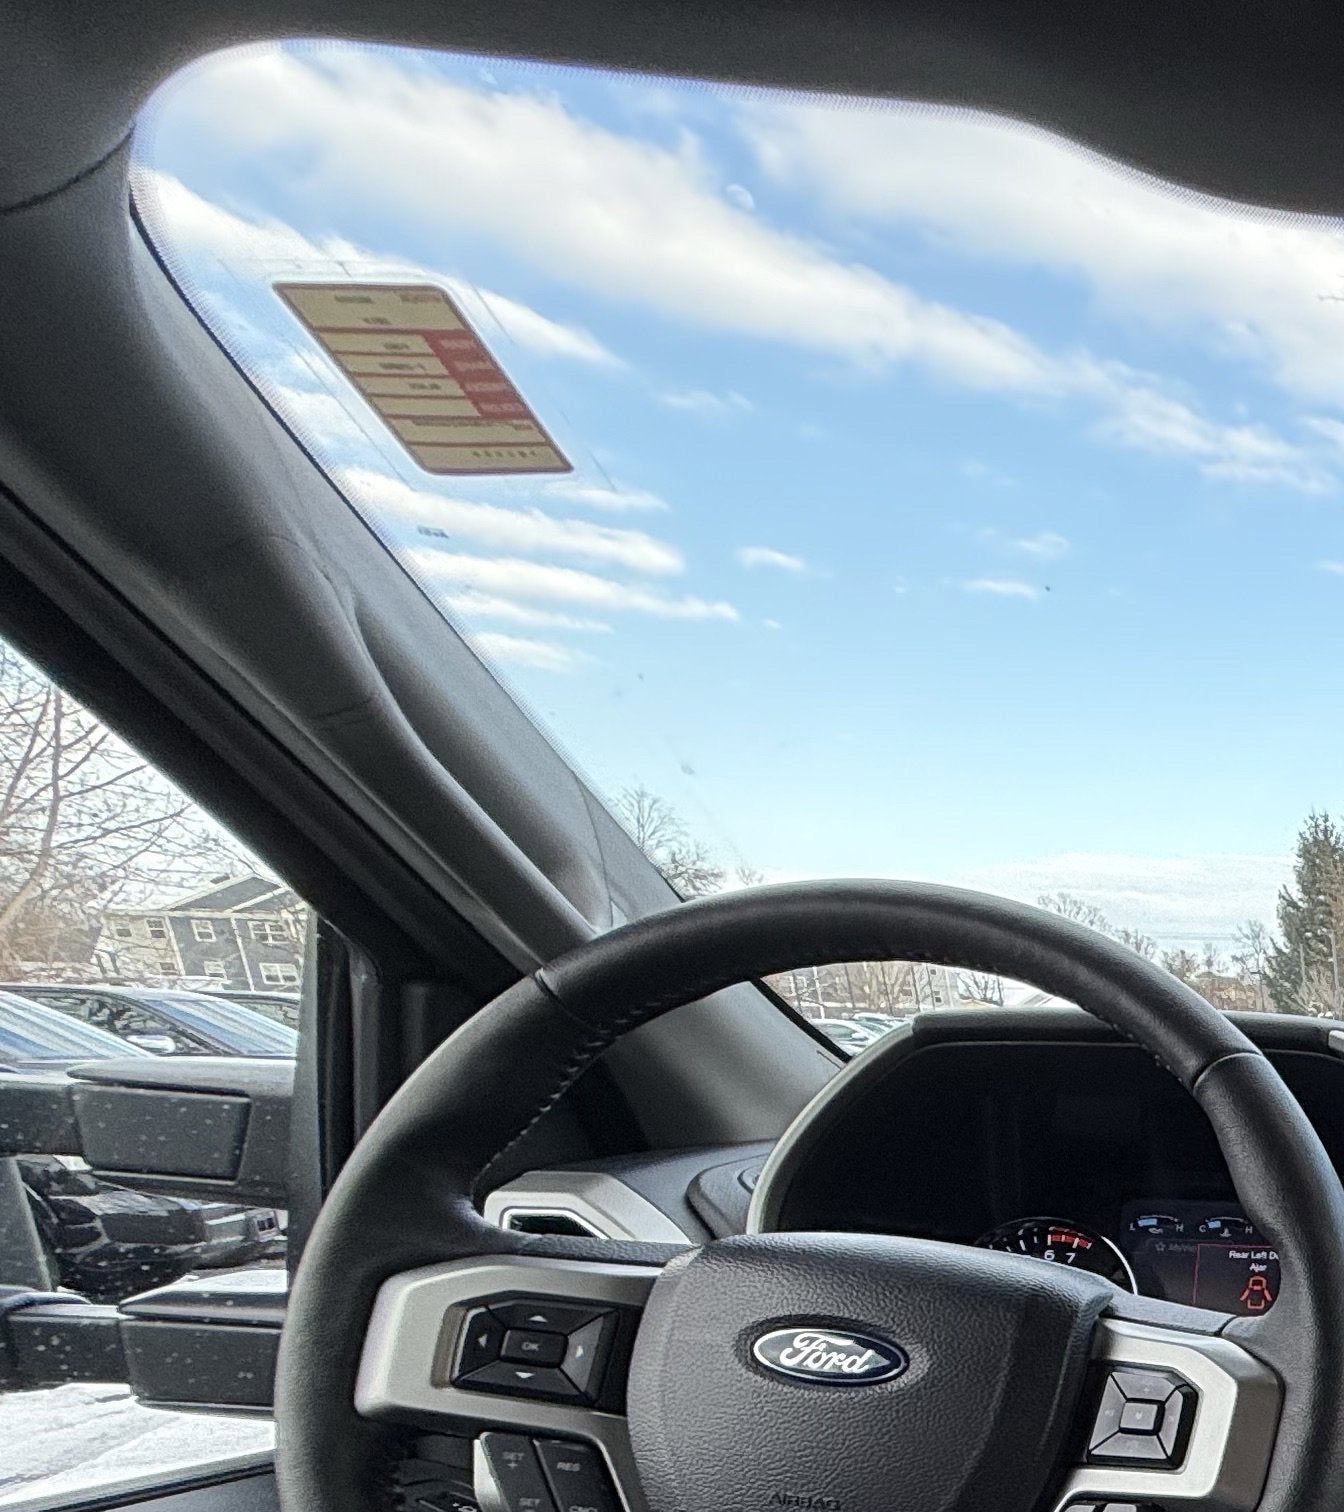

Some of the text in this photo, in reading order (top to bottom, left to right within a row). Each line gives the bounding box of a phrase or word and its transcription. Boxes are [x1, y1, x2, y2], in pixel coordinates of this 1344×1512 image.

[1043, 1250, 1055, 1261] 6
[1065, 1253, 1076, 1264] 7
[1229, 1250, 1249, 1259] Rear
[1251, 1250, 1267, 1259] Left
[521, 1341, 540, 1351] OK
[779, 1332, 874, 1374] Ford
[556, 1461, 581, 1472] RES
